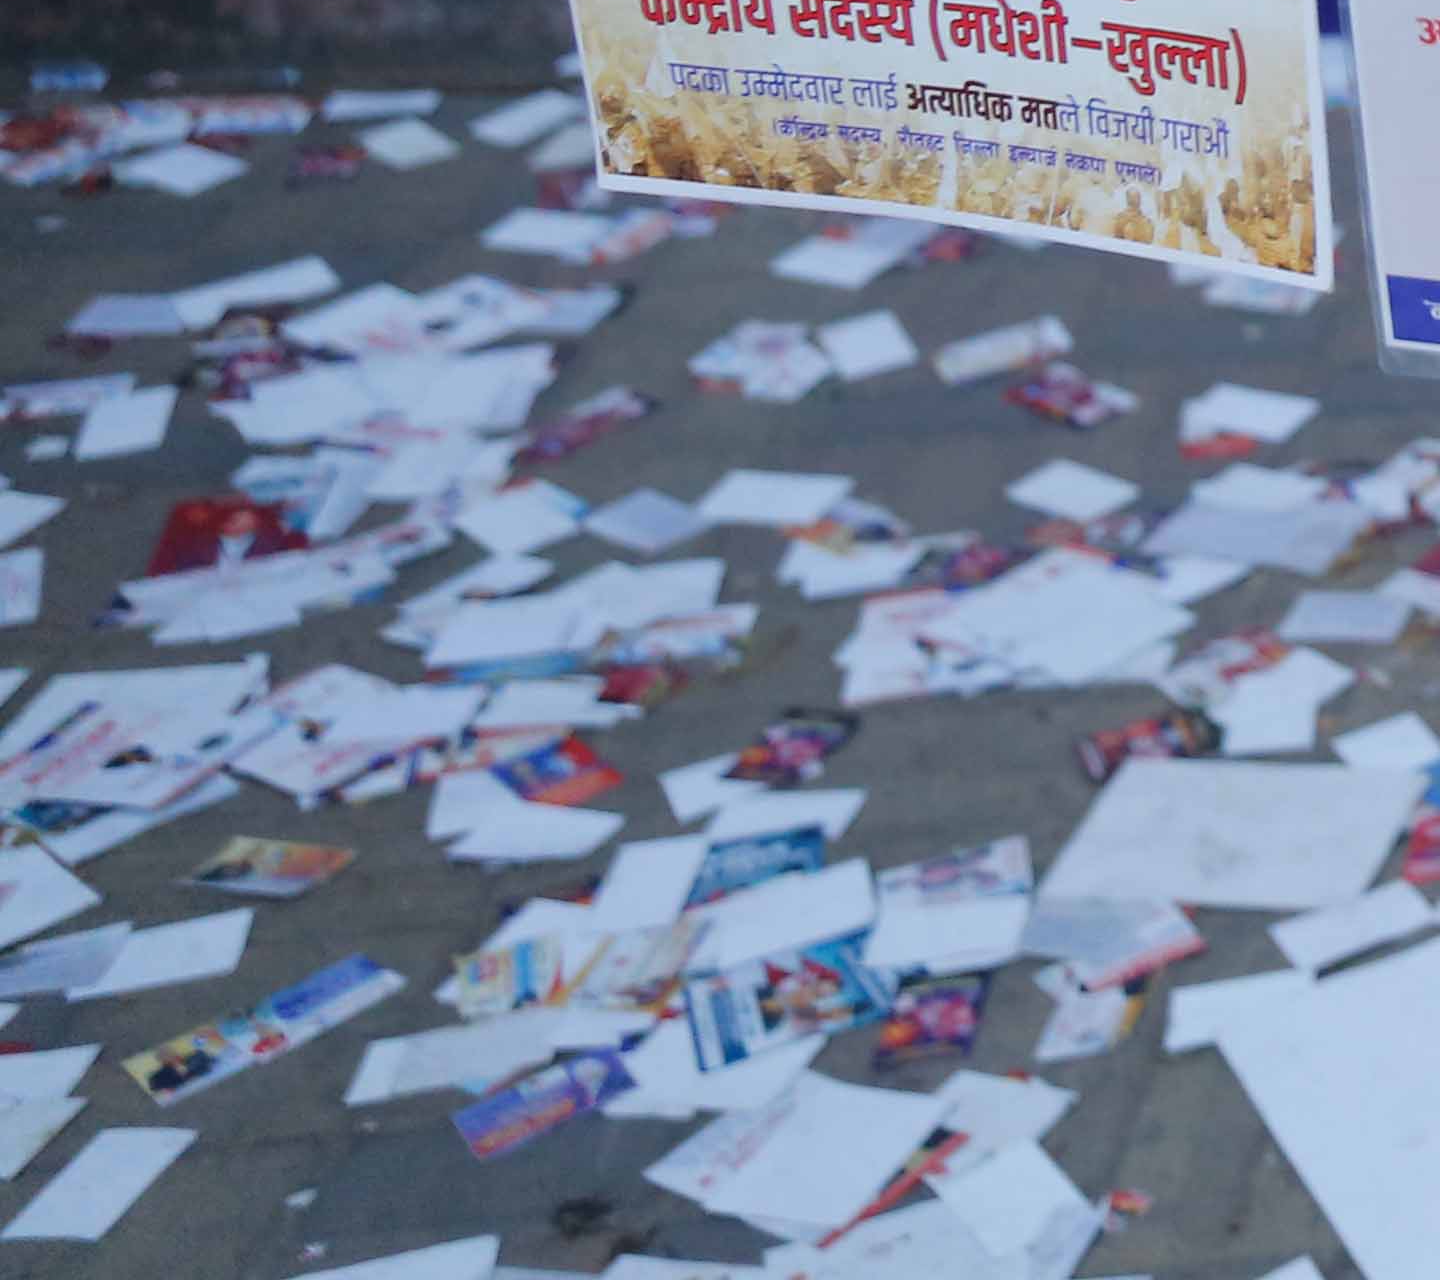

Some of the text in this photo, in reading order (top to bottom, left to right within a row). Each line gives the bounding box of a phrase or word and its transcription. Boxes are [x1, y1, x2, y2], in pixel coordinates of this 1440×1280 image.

[668, 62, 1156, 146] पदका उम्मेदवार लाई अत्याधिक मतले विजयी
